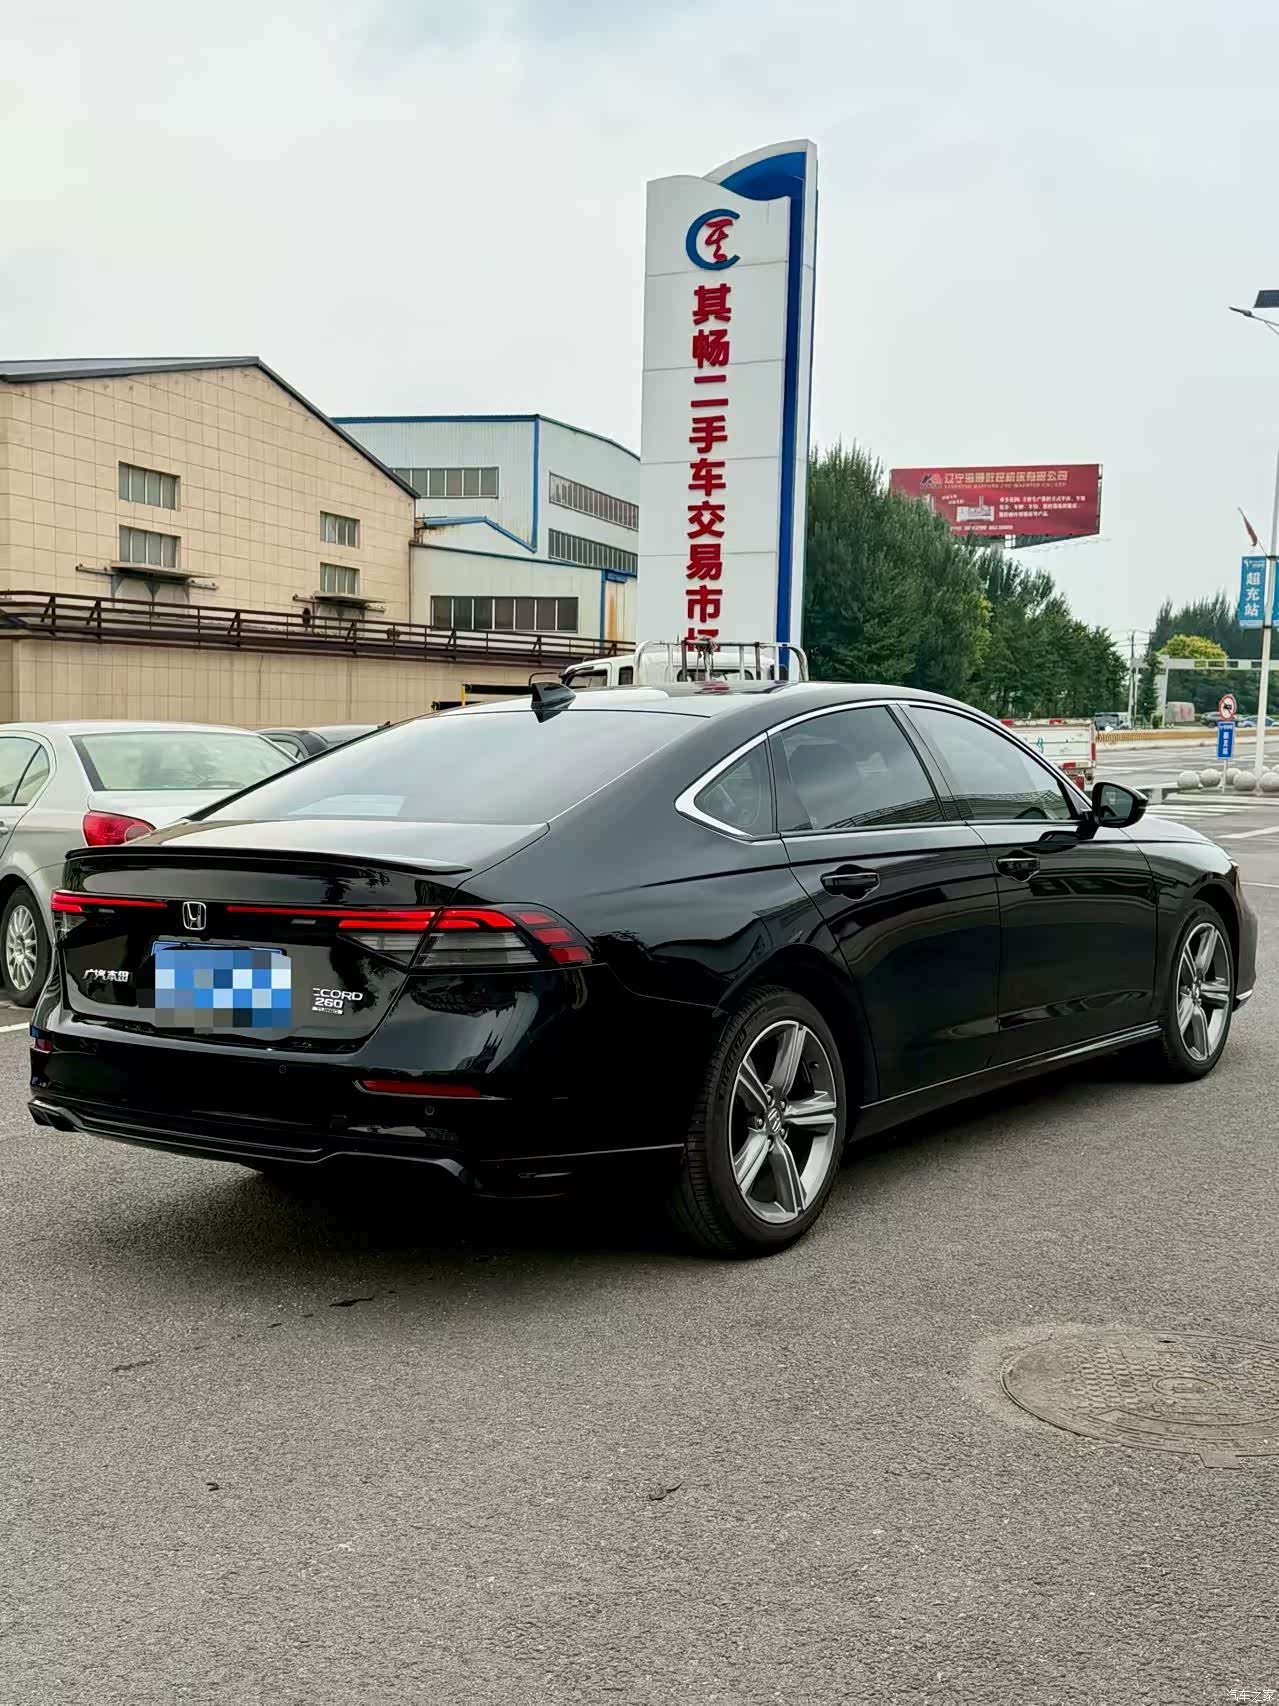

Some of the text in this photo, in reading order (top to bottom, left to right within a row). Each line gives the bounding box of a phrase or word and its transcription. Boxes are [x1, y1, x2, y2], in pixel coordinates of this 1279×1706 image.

[1244, 571, 1261, 617] 超充站
[315, 997, 343, 1009] 260
